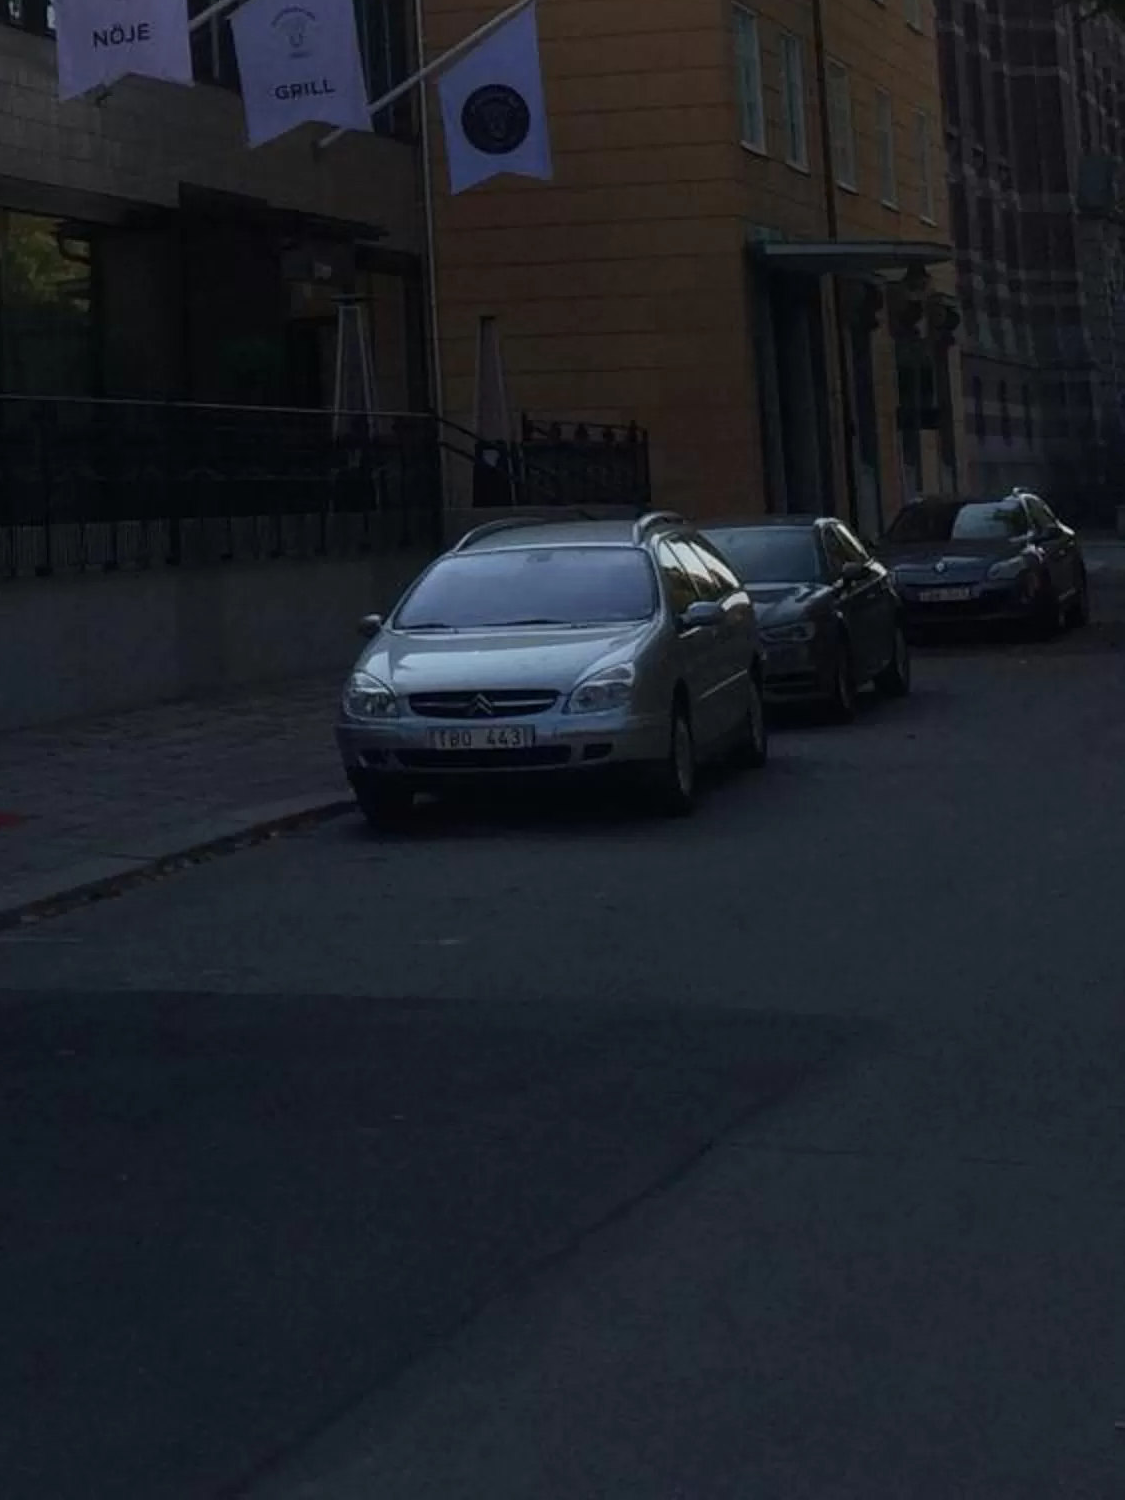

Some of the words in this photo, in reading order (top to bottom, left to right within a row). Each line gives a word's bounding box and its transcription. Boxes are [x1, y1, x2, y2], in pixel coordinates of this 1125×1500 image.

[92, 22, 152, 49] NÖJE
[274, 78, 336, 100] GRILL
[485, 728, 522, 746] 443
